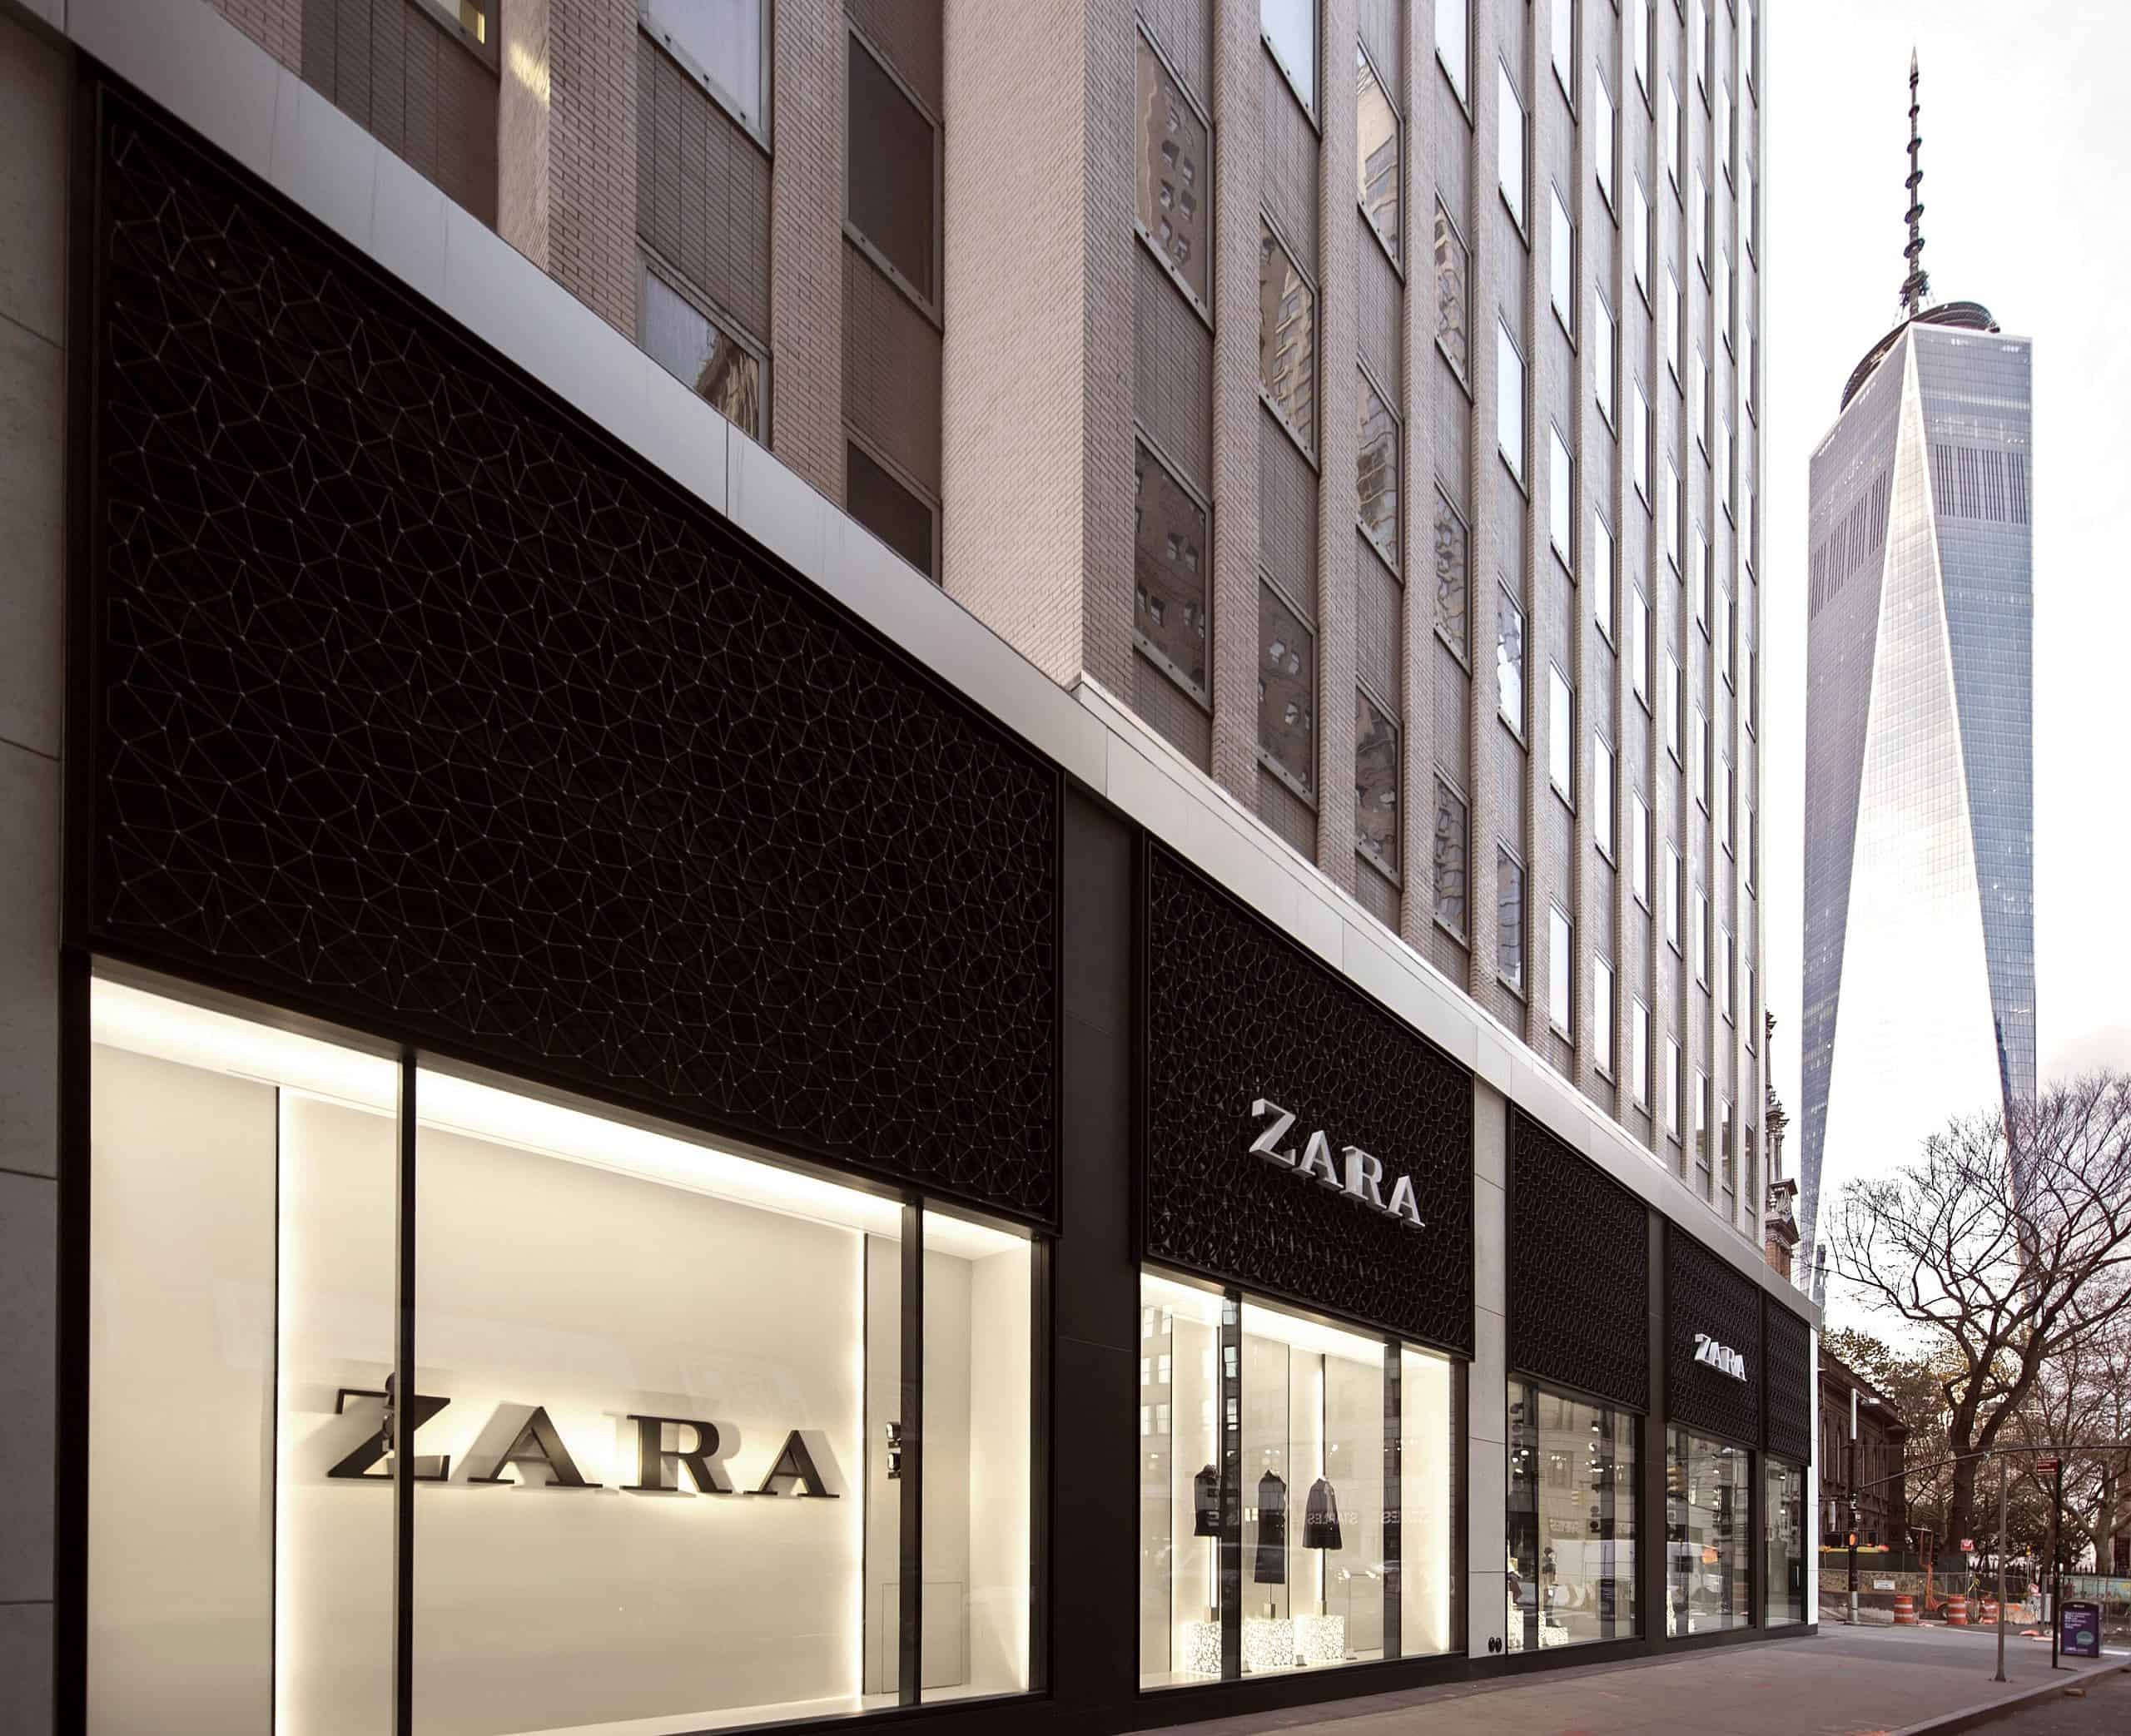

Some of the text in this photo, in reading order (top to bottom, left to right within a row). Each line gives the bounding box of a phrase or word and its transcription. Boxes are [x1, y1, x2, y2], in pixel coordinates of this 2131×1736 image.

[1249, 1098, 1426, 1229] ZARA
[1694, 1333, 1747, 1382] ZARA
[325, 1388, 840, 1500] ZARA
